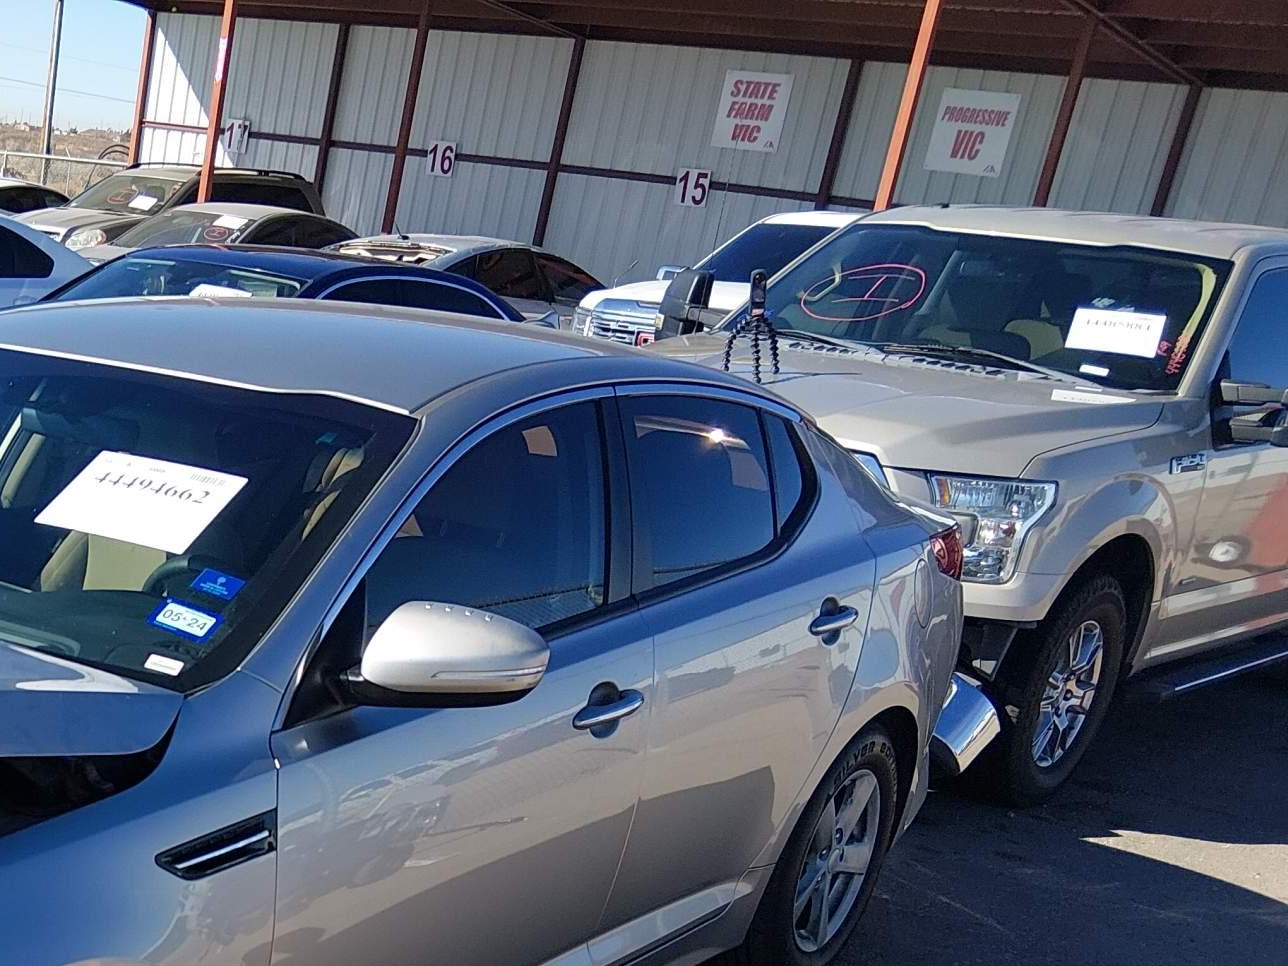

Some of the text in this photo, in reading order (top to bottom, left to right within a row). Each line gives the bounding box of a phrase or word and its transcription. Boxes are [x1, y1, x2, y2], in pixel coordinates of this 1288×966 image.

[730, 79, 781, 100] STATE
[726, 101, 774, 122] FARM
[941, 105, 1011, 127] PROGRESSIVE
[226, 122, 249, 150] 17
[731, 123, 761, 143] VIC
[950, 129, 985, 161] VIC
[428, 143, 454, 175] 16
[678, 170, 709, 206] 15
[94, 471, 210, 504] 44494662
